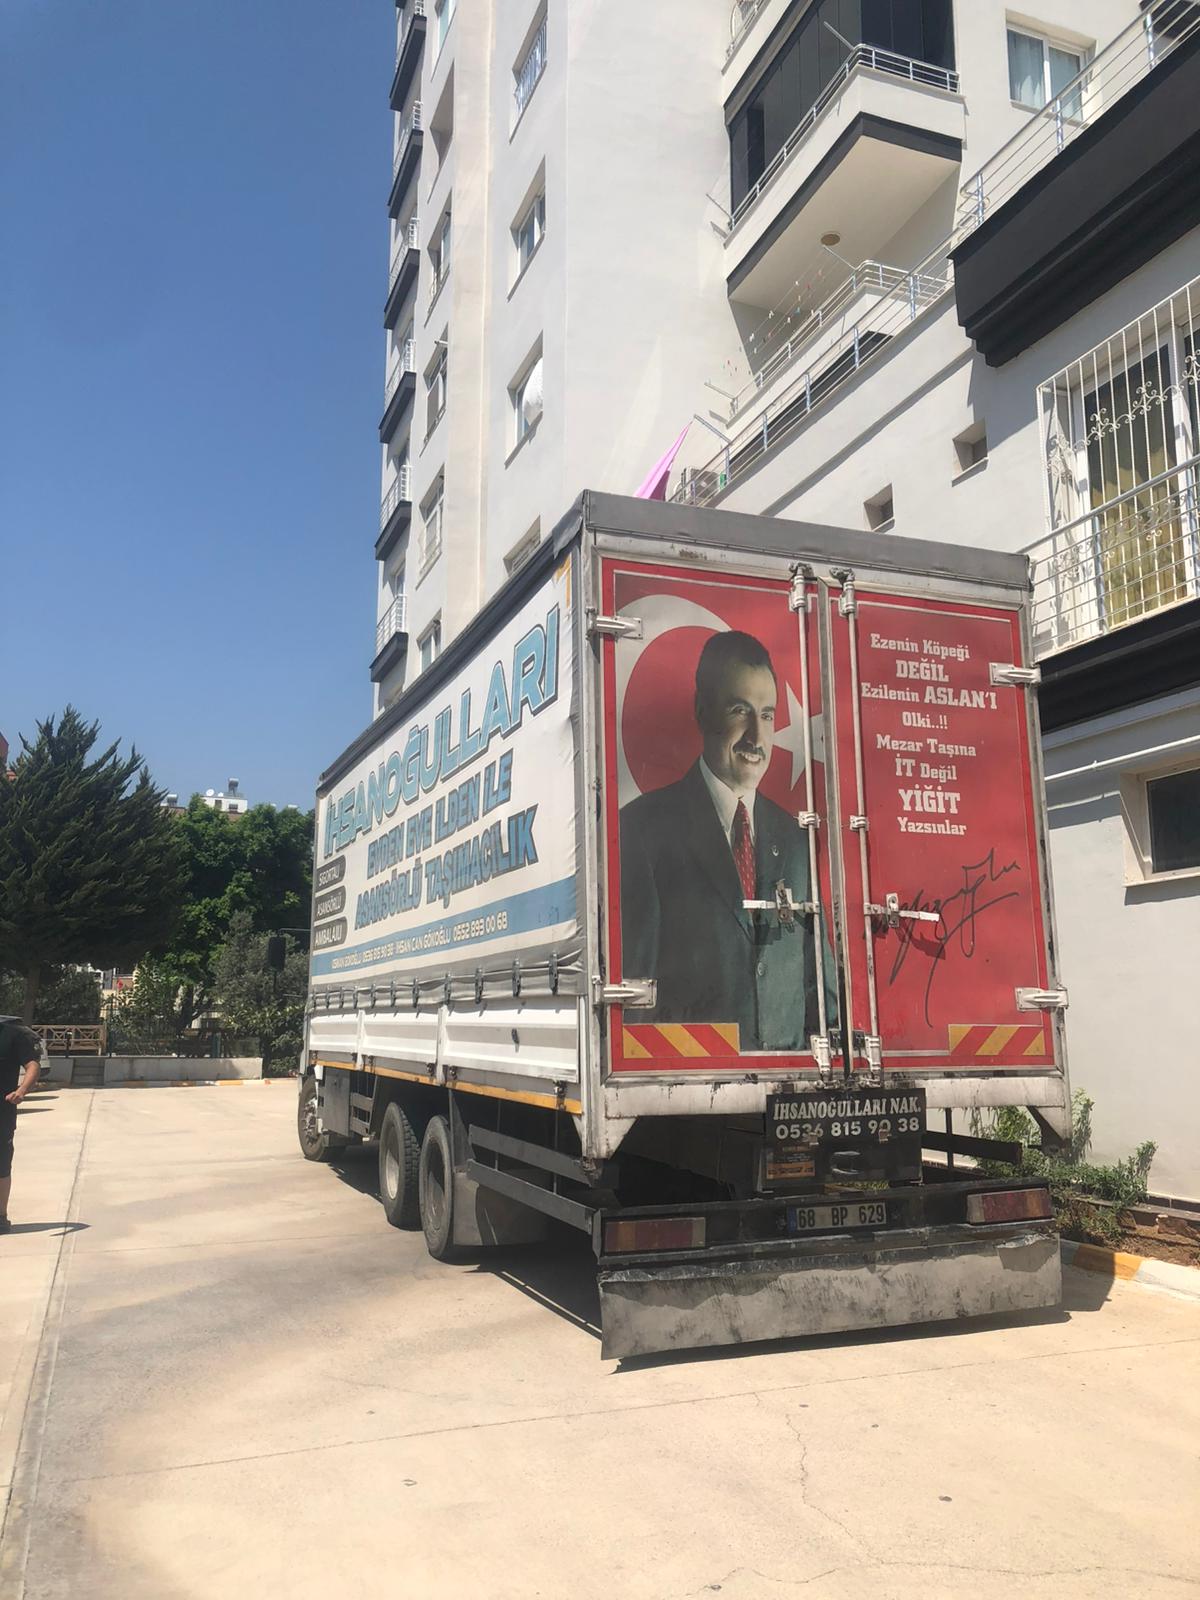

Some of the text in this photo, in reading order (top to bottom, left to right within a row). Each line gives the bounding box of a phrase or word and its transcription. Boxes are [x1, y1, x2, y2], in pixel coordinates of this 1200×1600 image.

[870, 632, 970, 662] Ezenin Köpeği
[895, 657, 949, 682] DEĞİL
[860, 682, 998, 710] Ezilenin ASLAN'I
[902, 711, 949, 730] Olki..!!
[876, 733, 977, 758] Mezar Taşına
[895, 753, 958, 783] İT Değil
[898, 784, 961, 814] YİĞİT
[897, 816, 967, 836] Yazsınlar
[367, 821, 405, 880] EVDEN
[405, 804, 433, 859] EVE
[354, 803, 540, 931] ASANSÖRLÜ TAŞIMACILIK
[485, 914, 496, 933] 00
[497, 911, 508, 930] 68
[773, 1096, 922, 1120] İHSANOĞULLARI NAK.
[831, 1120, 862, 1137] 815
[898, 1116, 920, 1133] 38
[798, 1204, 885, 1228] 68 BP 629
